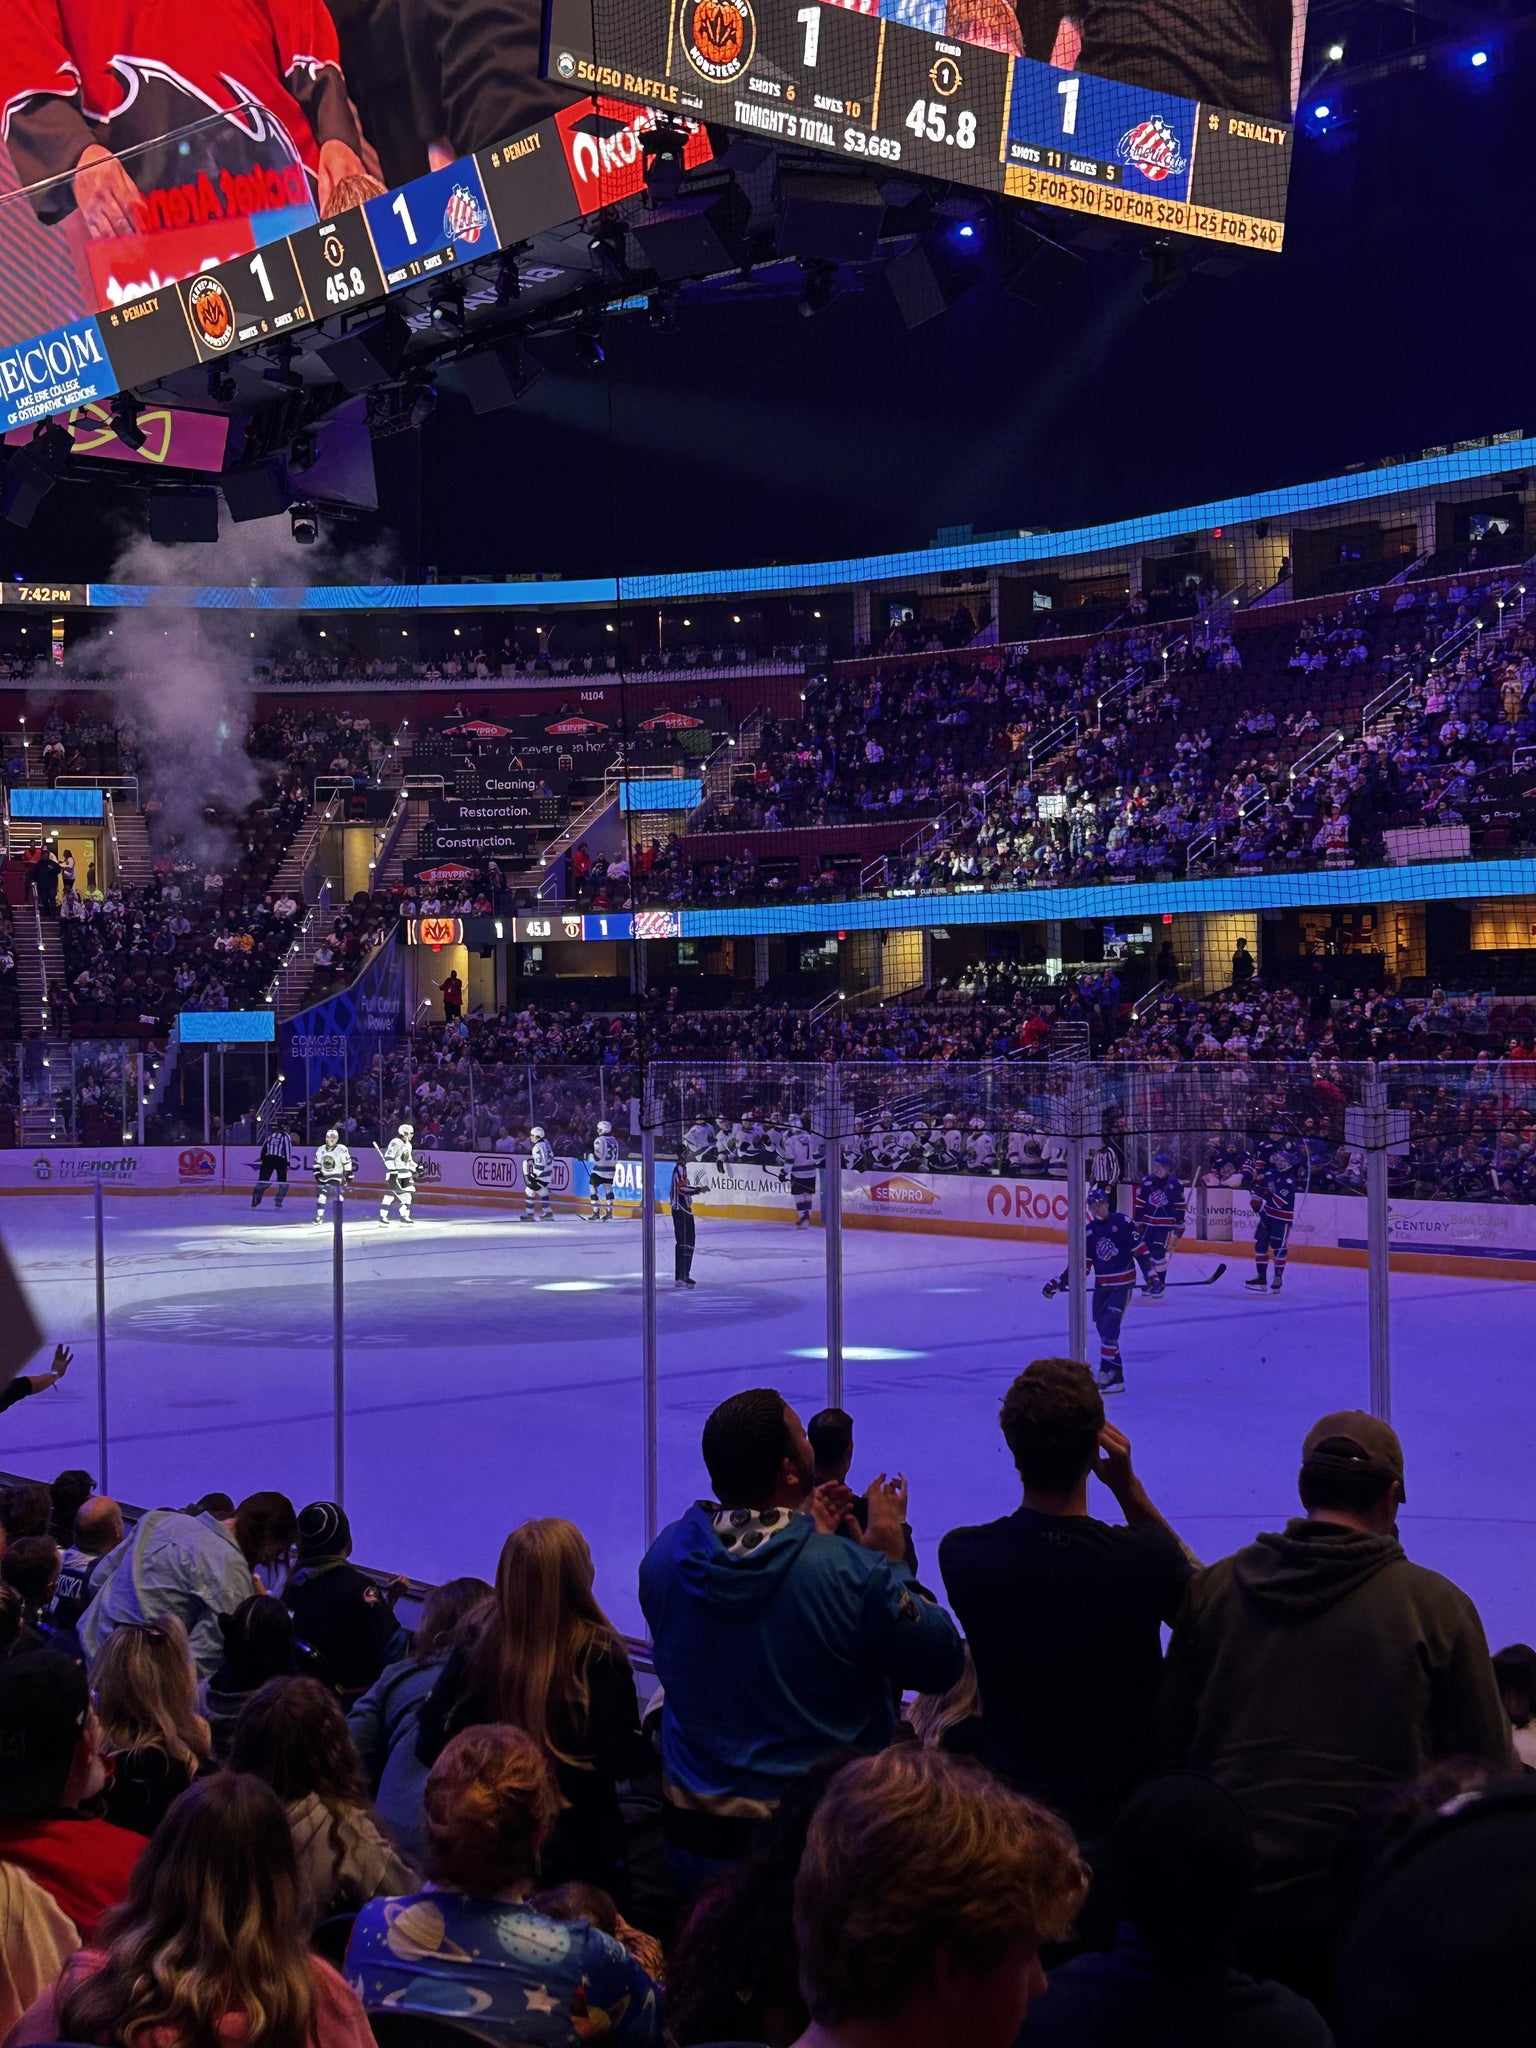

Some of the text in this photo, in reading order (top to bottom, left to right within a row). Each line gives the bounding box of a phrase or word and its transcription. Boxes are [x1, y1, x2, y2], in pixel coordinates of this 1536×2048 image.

[797, 6, 821, 67] 1
[623, 73, 679, 104] RAFFLE
[749, 77, 796, 101] SHOTS 6
[942, 67, 950, 85] 1
[845, 101, 861, 118] 10
[1057, 78, 1080, 135] 1
[734, 100, 797, 137] TONIGHT'S
[799, 117, 836, 147] TOTAL
[843, 128, 902, 161] $3,683
[905, 99, 977, 150] 45.8
[1229, 118, 1287, 146] PENALTY
[503, 132, 541, 164] PENALTY
[1011, 144, 1062, 168] SHOTS 11
[1105, 165, 1115, 181] 5
[1028, 176, 1095, 207] 5 FOR $10
[392, 192, 418, 245] 1
[1104, 193, 1184, 225] 50 FOR $20
[1195, 212, 1278, 244] 125 FOR $40
[330, 244, 338, 257] 1
[409, 261, 421, 276] 11
[446, 247, 454, 261] 5
[250, 253, 274, 303] 1
[325, 266, 365, 304] 45.8
[122, 298, 159, 324] PENALTY
[261, 319, 268, 333] 6
[294, 306, 306, 321] 10
[0, 329, 103, 402] ECOM
[7, 384, 98, 425] OF OSTEOPATHIC MEDICINE
[16, 378, 81, 410] LAKE ERIE COLLEGE
[580, 691, 604, 701] M104
[485, 779, 539, 791] Cleaning.
[459, 805, 531, 818] Restoration.
[436, 837, 516, 849] Construction.
[495, 922, 504, 939] 1
[599, 919, 608, 937] 1
[291, 1035, 346, 1046] COMCAST
[291, 1047, 346, 1058] BUSINESS
[477, 1162, 513, 1183] RE-BATH
[711, 1176, 792, 1194] MEDICAL MUTU
[876, 1187, 923, 1202] SERVPRO
[1394, 1220, 1450, 1232] CENTURY
